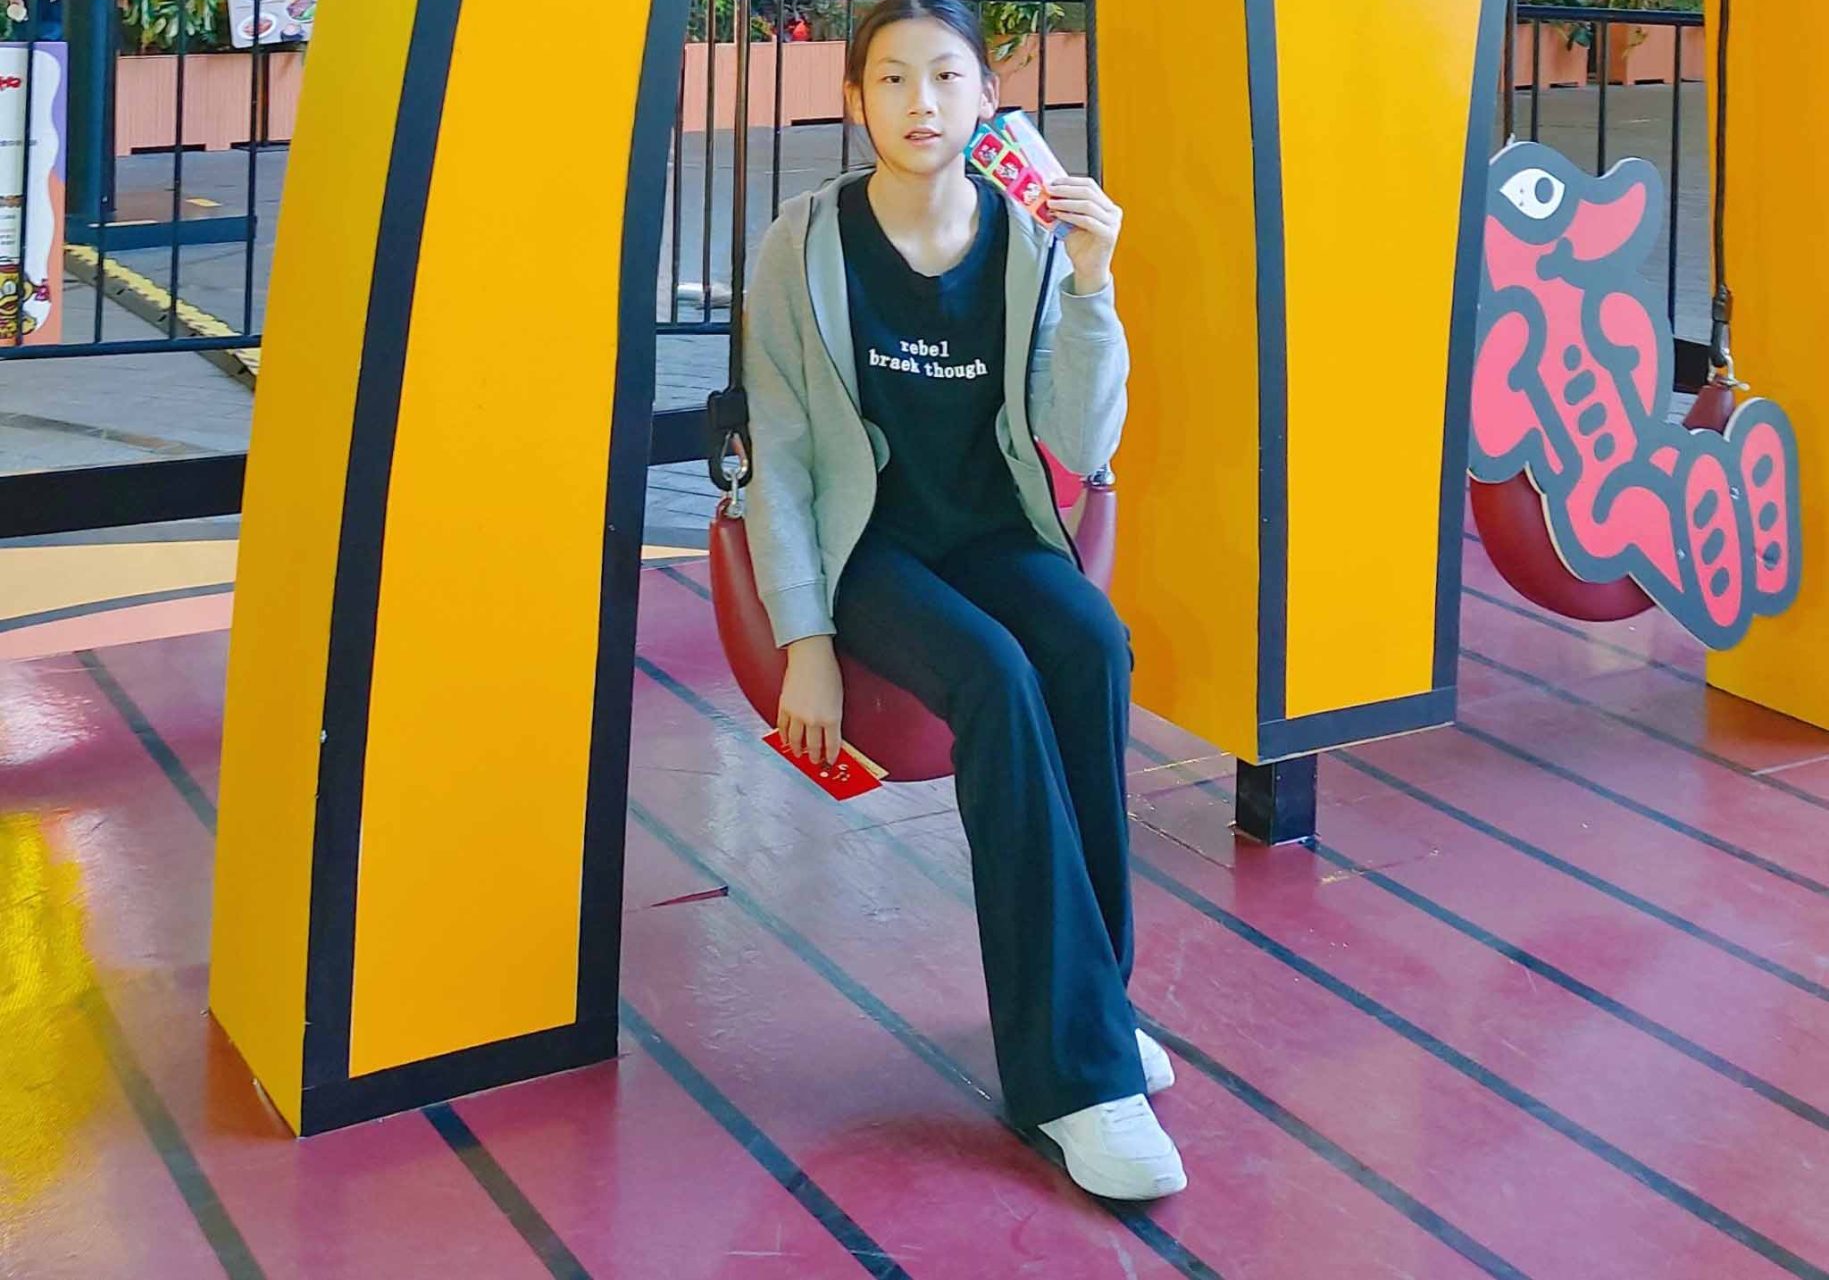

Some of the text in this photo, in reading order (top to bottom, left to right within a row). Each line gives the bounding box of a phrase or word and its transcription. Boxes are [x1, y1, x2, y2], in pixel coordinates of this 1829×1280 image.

[900, 339, 950, 357] rebel
[869, 349, 988, 379] braek though
